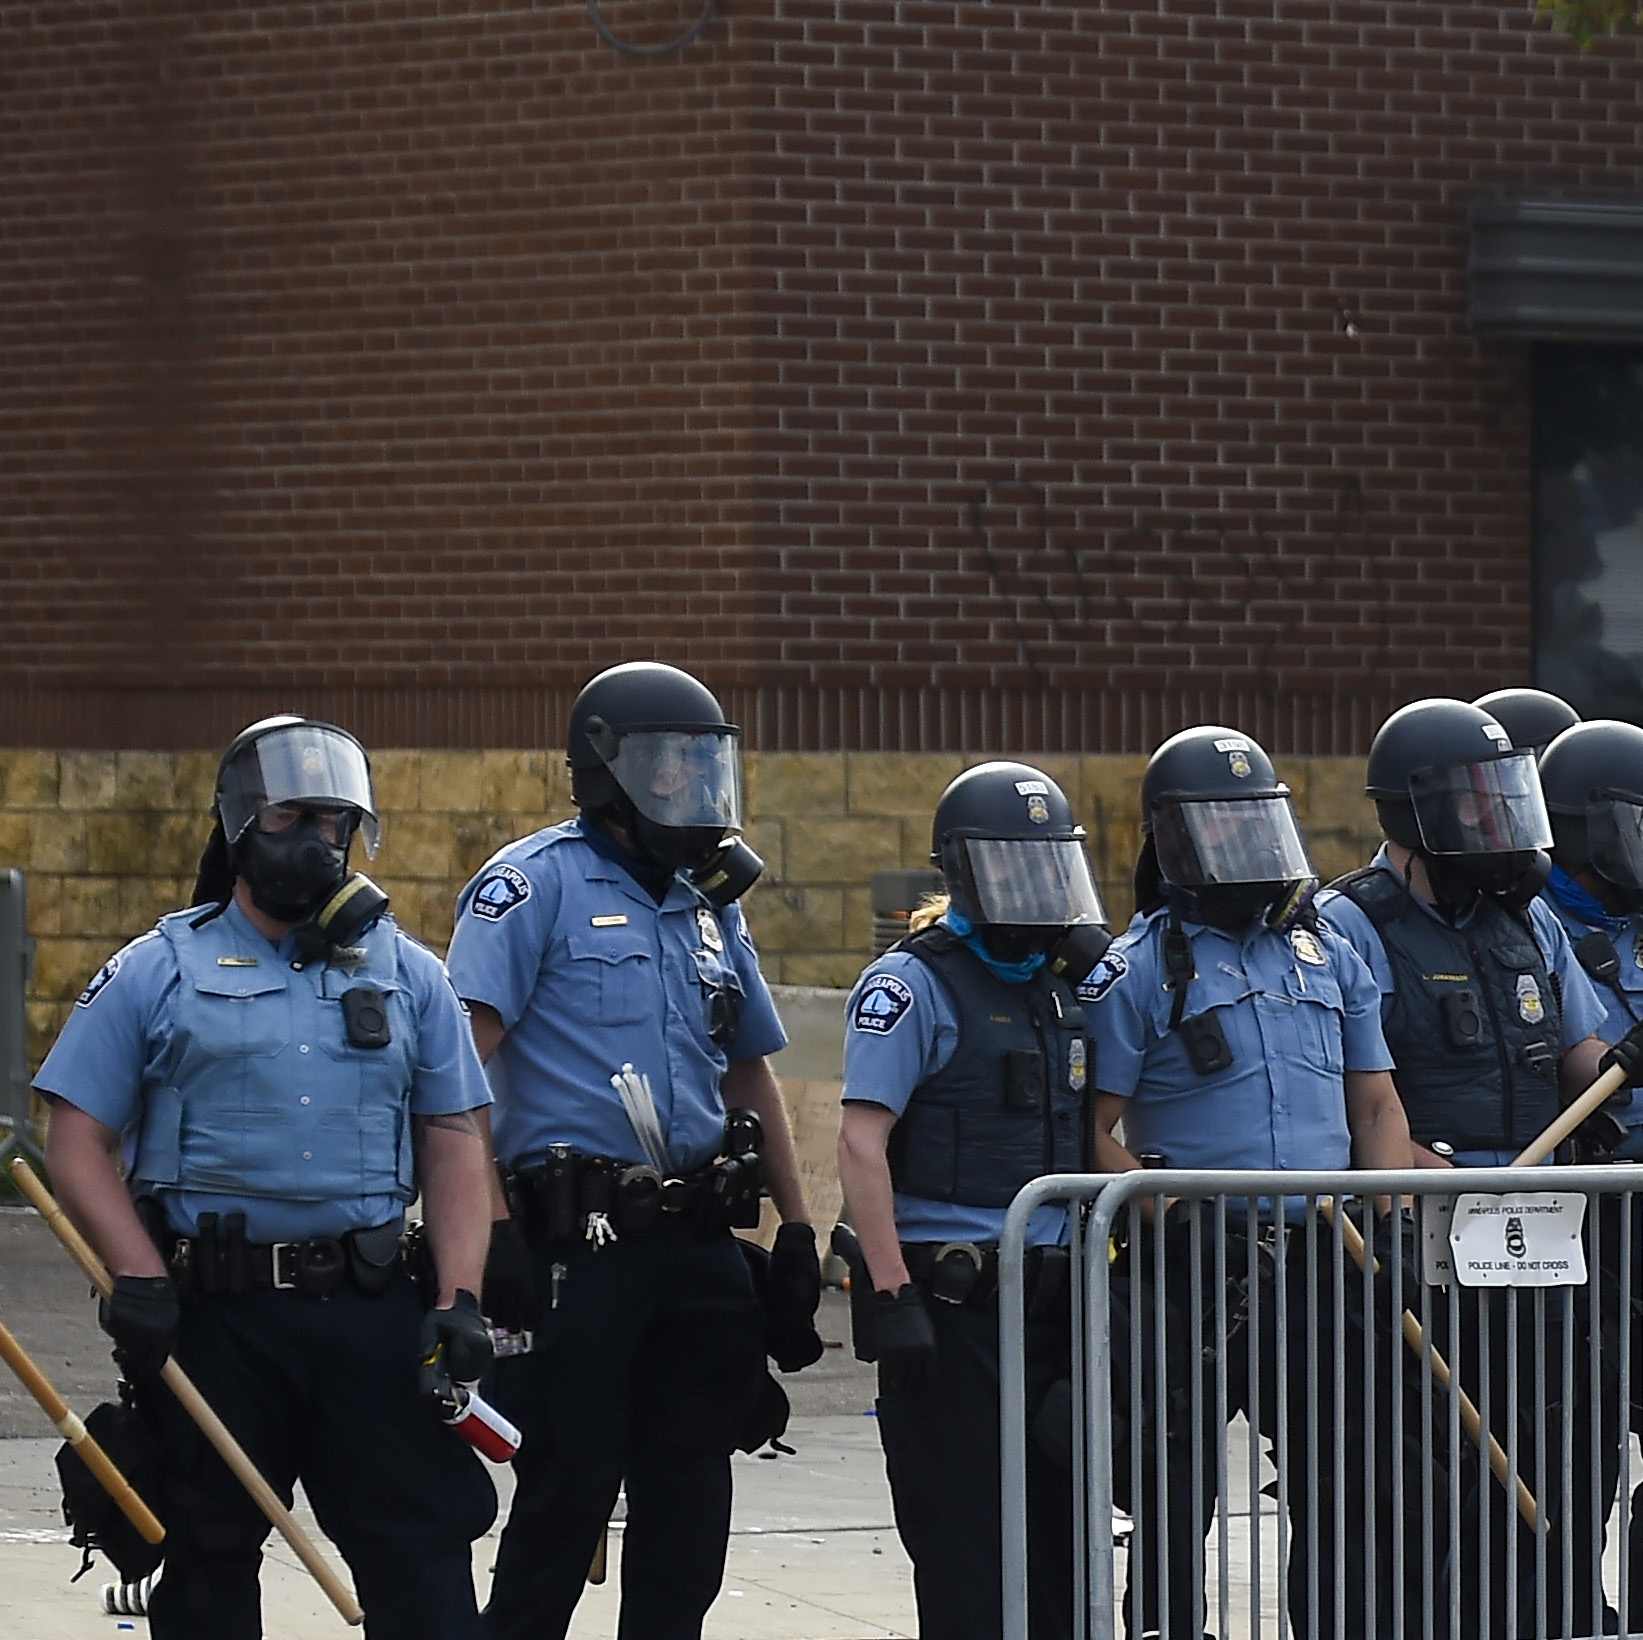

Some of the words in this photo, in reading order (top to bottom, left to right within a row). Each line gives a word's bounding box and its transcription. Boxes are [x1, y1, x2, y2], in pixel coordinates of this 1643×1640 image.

[1501, 1206, 1524, 1214] POLICE
[1468, 1261, 1494, 1270] POLICE
[1494, 1261, 1511, 1270] LINE
[1517, 1261, 1527, 1270] DO
[1528, 1261, 1541, 1270] NOT
[1542, 1261, 1569, 1270] CROSS
